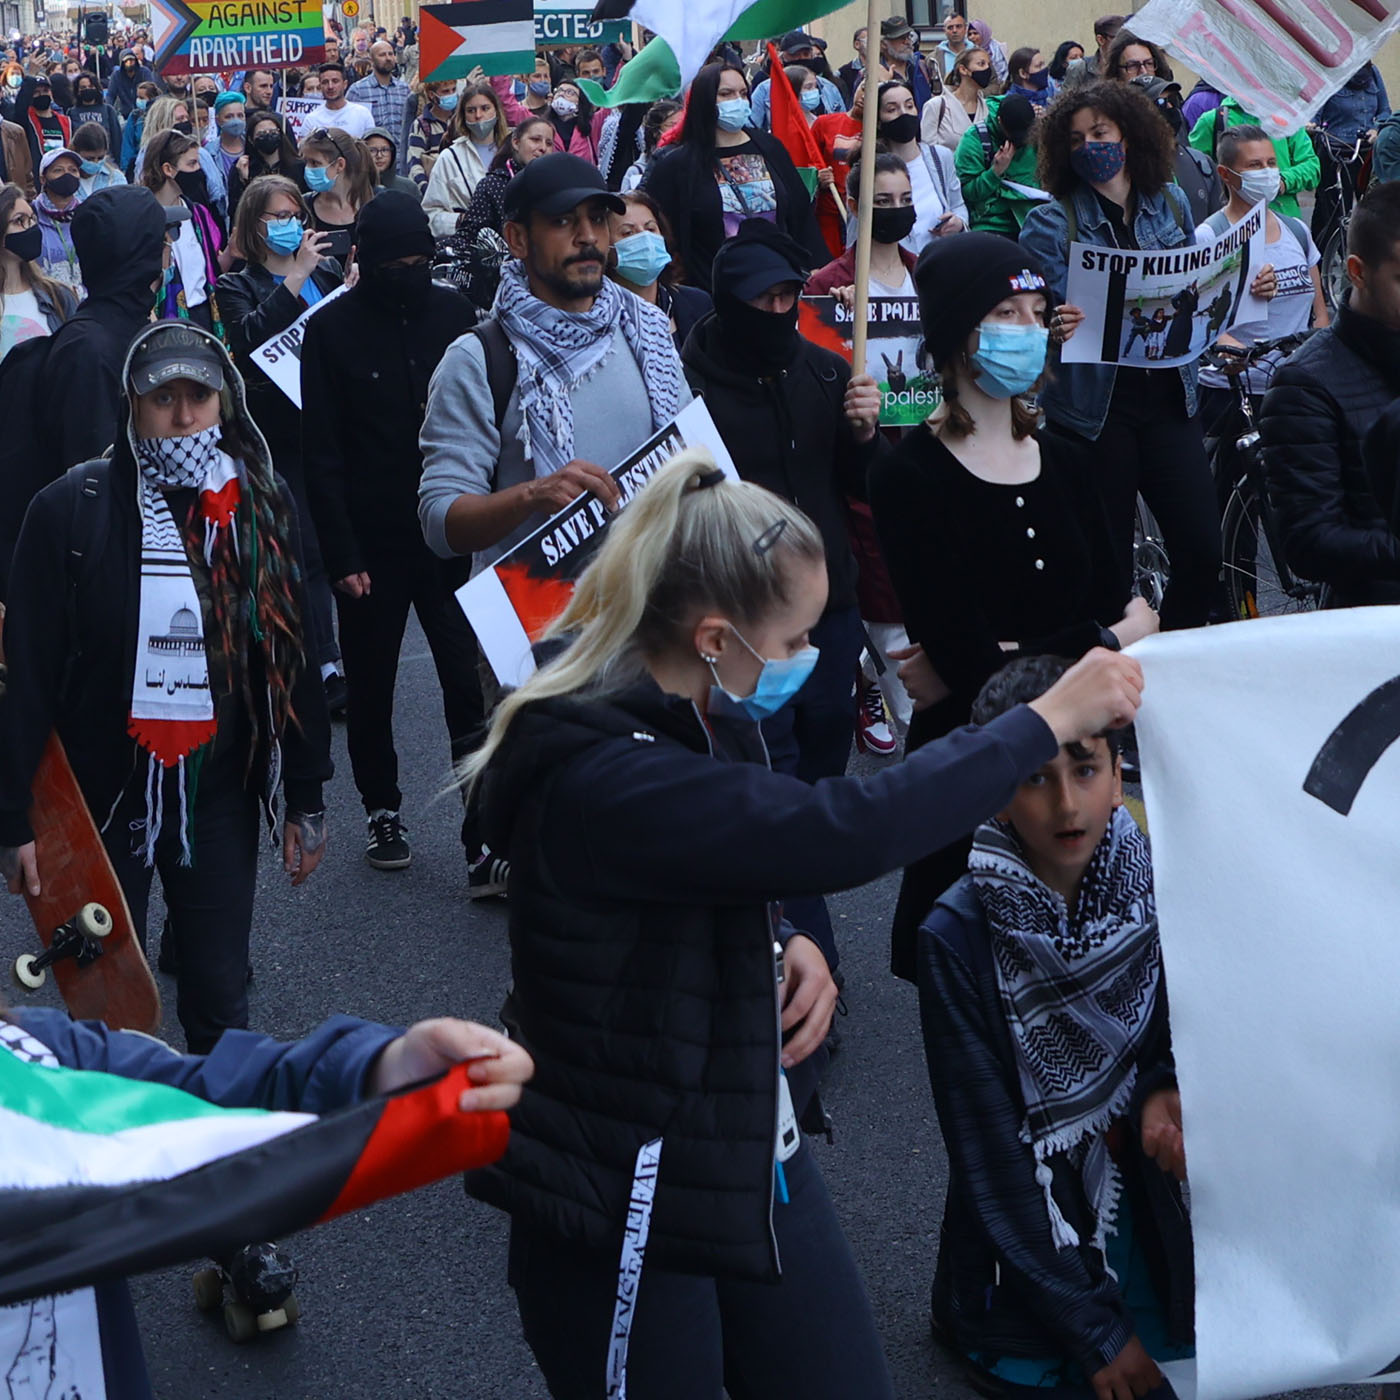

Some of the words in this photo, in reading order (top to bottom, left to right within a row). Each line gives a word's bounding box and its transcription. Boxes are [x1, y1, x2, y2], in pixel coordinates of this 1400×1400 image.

[208, 0, 307, 29] AGAINST
[189, 33, 303, 68] APARTHEID
[1081, 249, 1138, 275] STOP
[1142, 246, 1211, 276] KILLING
[1213, 209, 1262, 261] CHILDREN
[262, 327, 301, 364] STOP
[540, 505, 597, 567] SAVE
